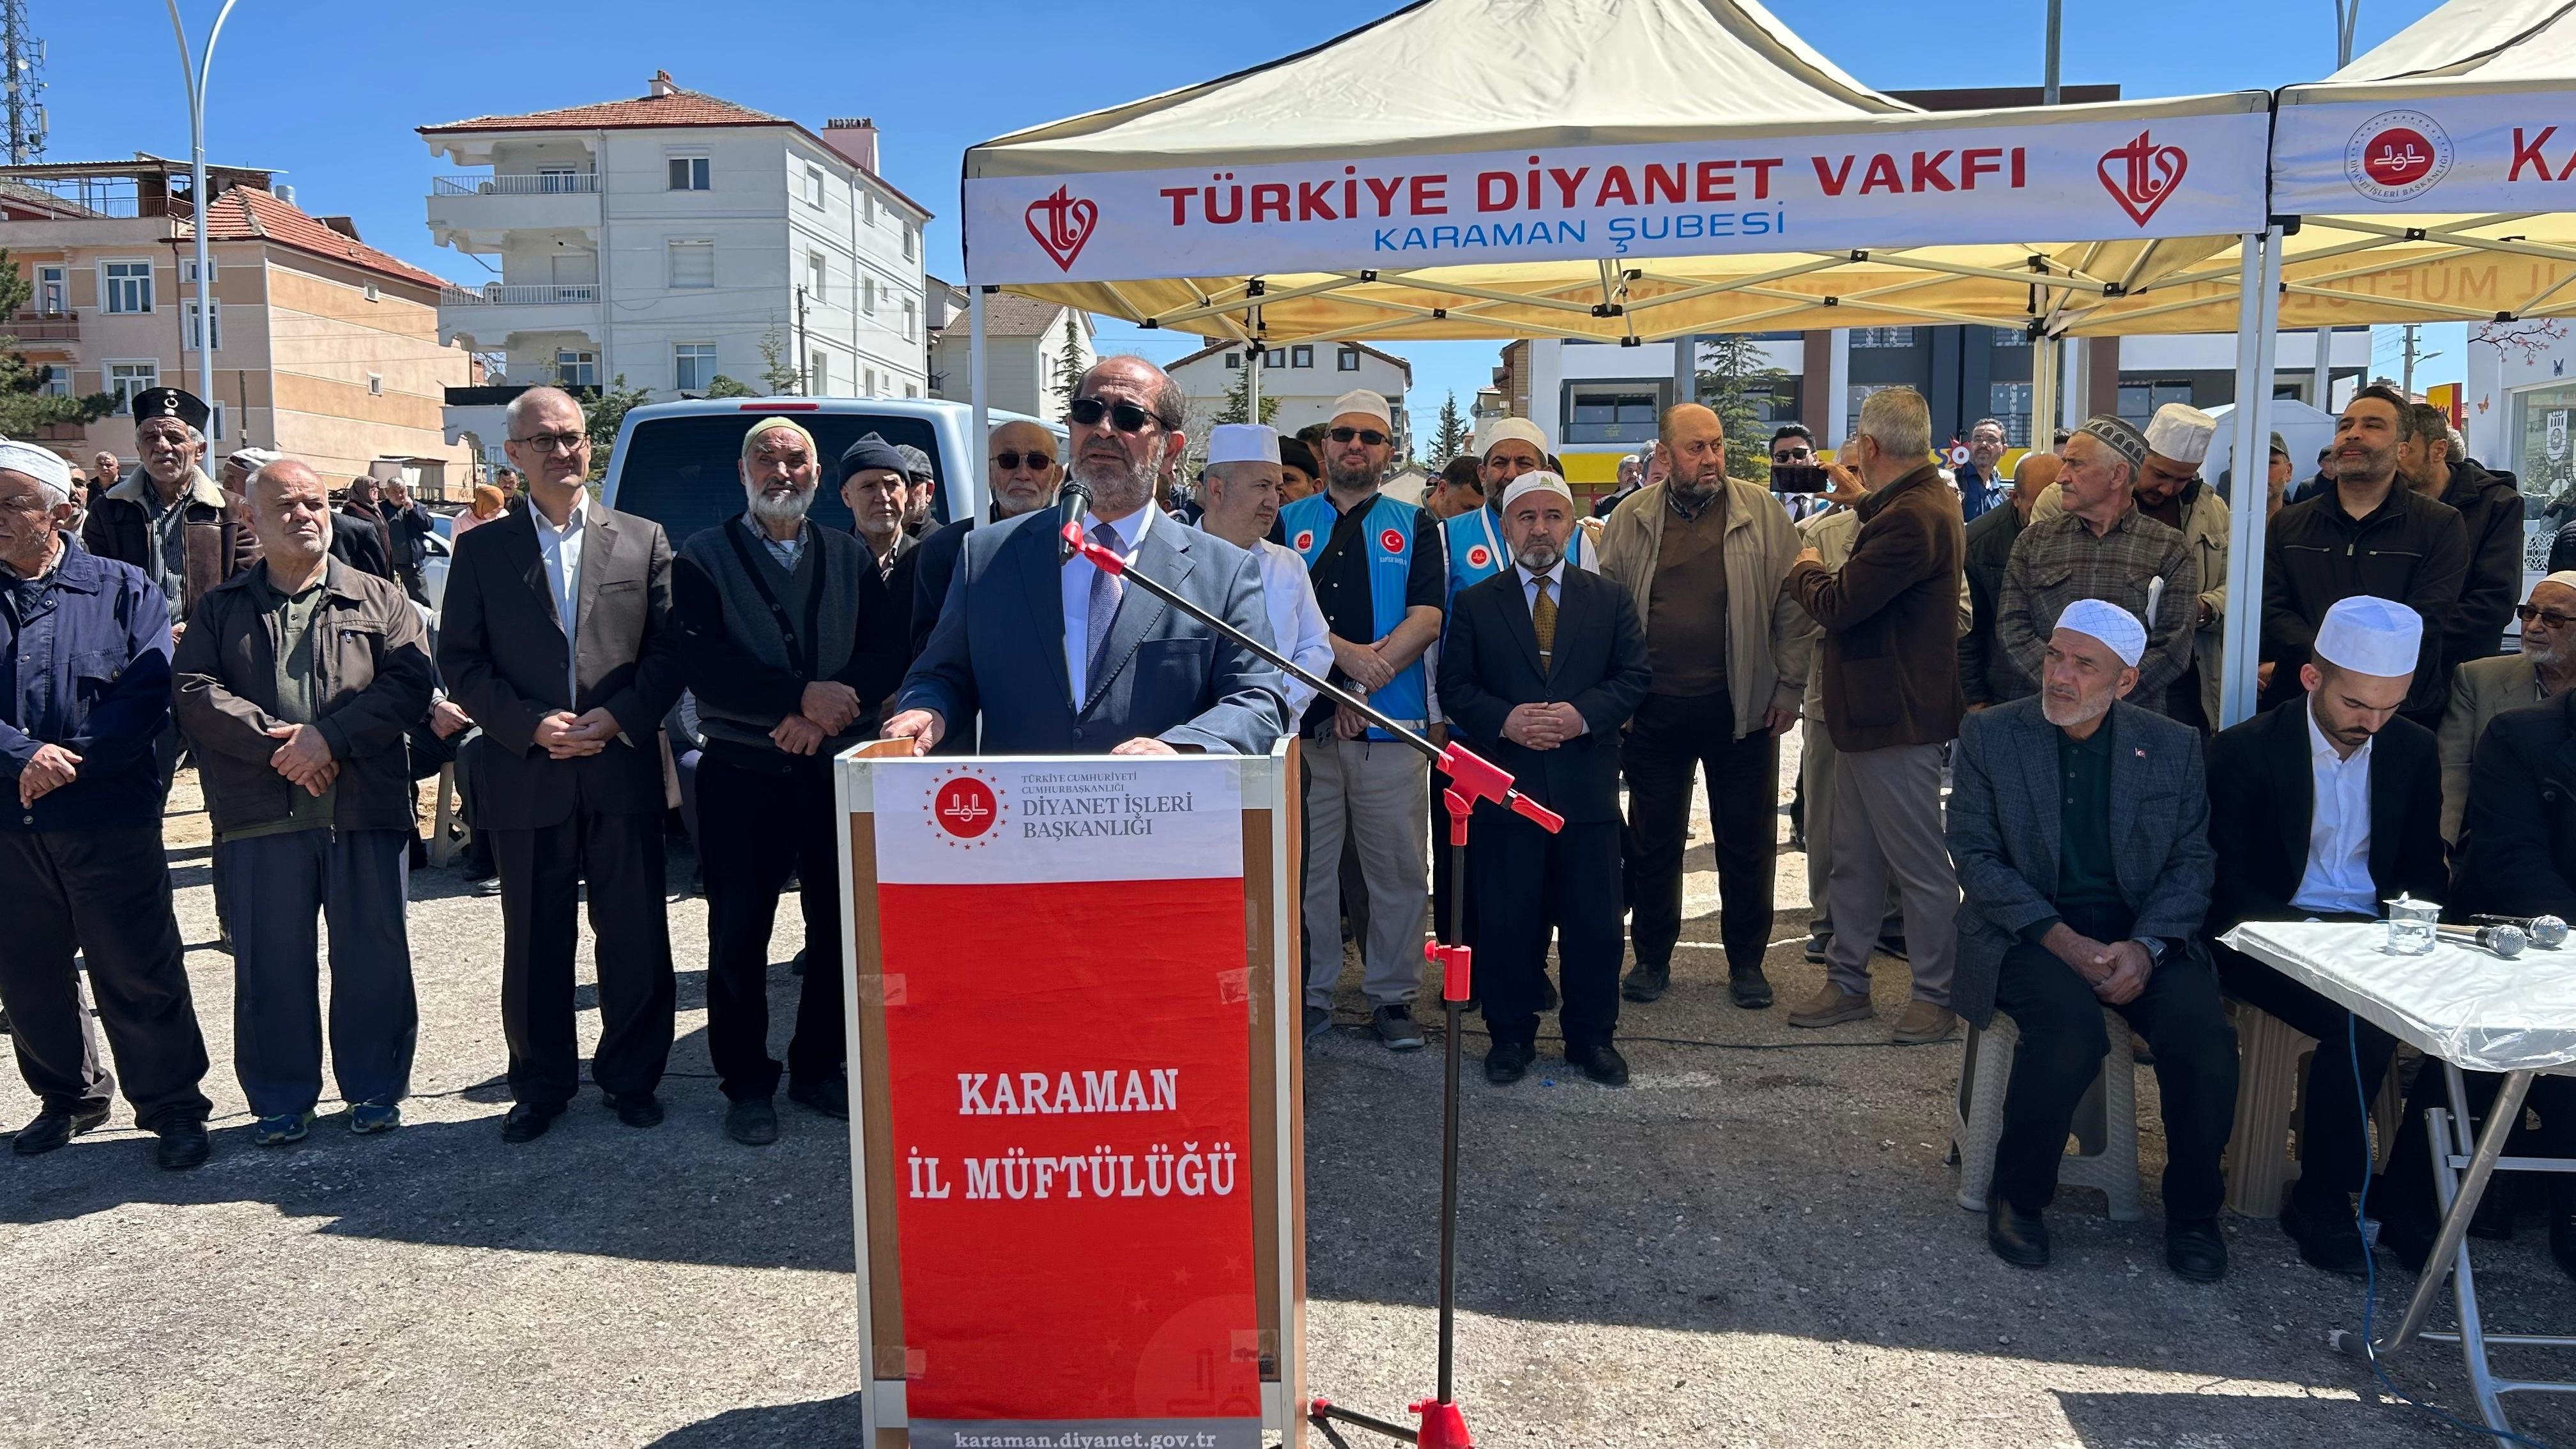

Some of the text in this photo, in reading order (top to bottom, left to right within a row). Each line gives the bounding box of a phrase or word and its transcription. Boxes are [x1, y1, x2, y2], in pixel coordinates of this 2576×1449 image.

[1160, 148, 2025, 226] TÜRKİYE DİYANET VAKFI
[1374, 201, 1784, 253] KARAMAN ŞUBESİ
[1021, 770, 1137, 784] TÜRKİYE CUMHURİYETİ
[1022, 783, 1125, 795] CUMHURBAŞKANLIĞI
[1022, 791, 1193, 818] DİYANET İŞLERİ
[1023, 815, 1153, 842] BAŞKANLIĞI
[957, 1068, 1179, 1116] KARAMAN
[908, 1140, 1238, 1200] İL MÜFTÜLÜĞÜ
[954, 1431, 1217, 1449] karaman.diyanet.gov.tr
